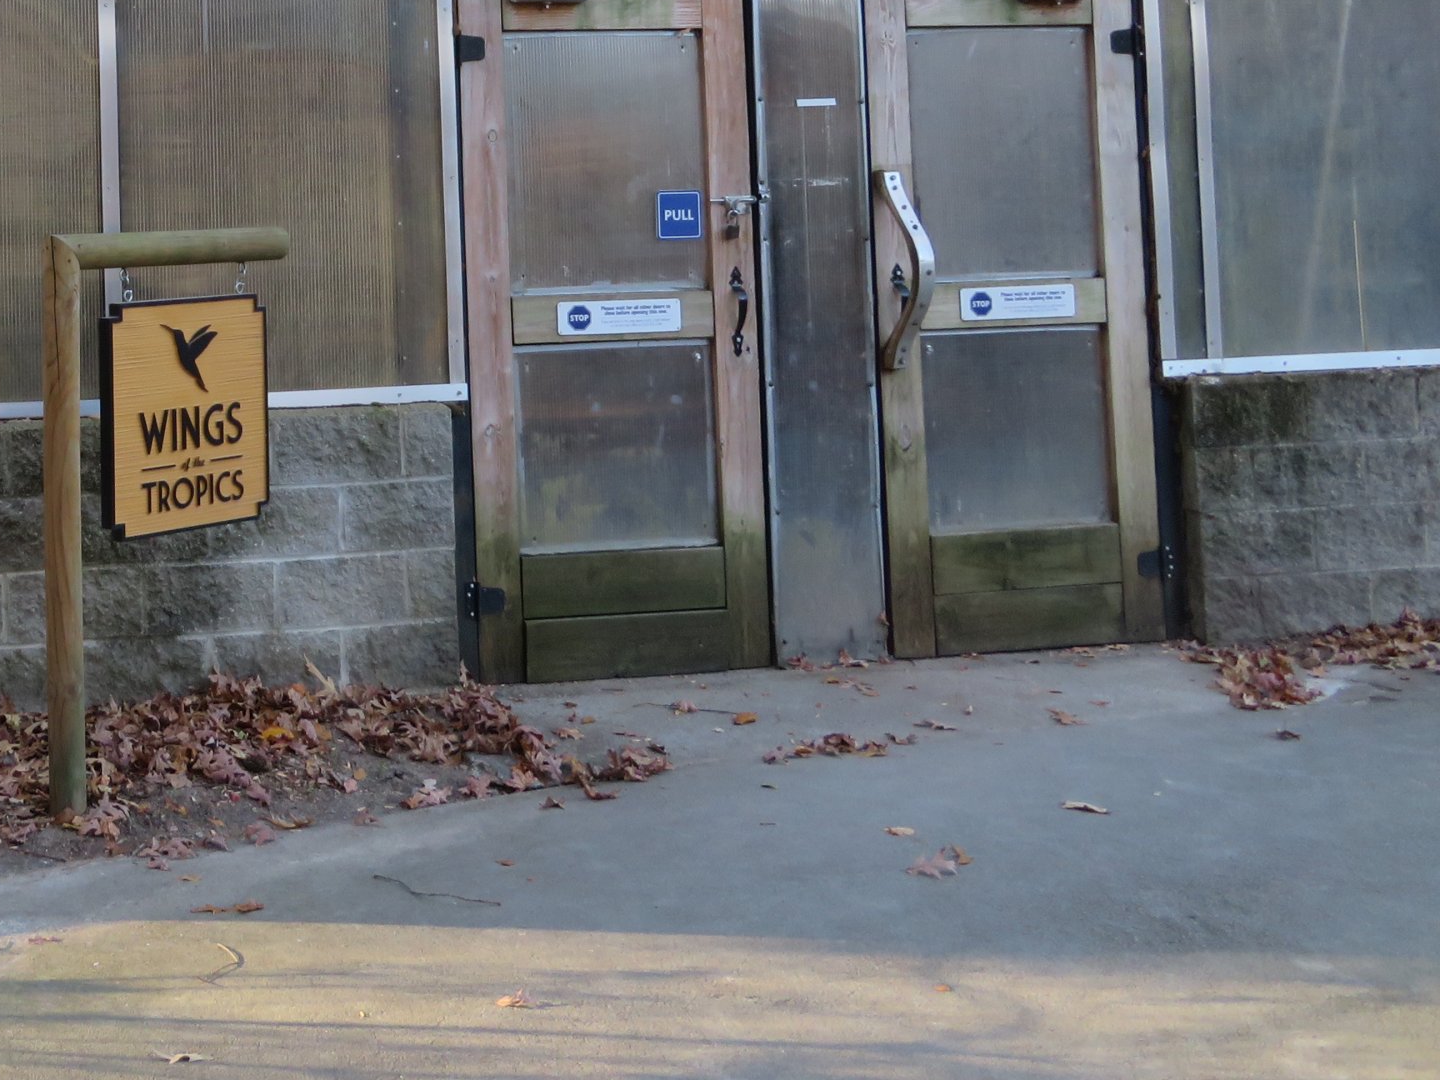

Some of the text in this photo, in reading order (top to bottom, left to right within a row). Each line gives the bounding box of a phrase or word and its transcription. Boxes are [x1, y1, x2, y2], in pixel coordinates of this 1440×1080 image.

[664, 209, 694, 221] PULL
[972, 300, 990, 308] STOP
[569, 314, 590, 322] STOP
[138, 402, 243, 455] WINGS
[181, 456, 205, 472] of the
[141, 469, 244, 515] TROPICS
